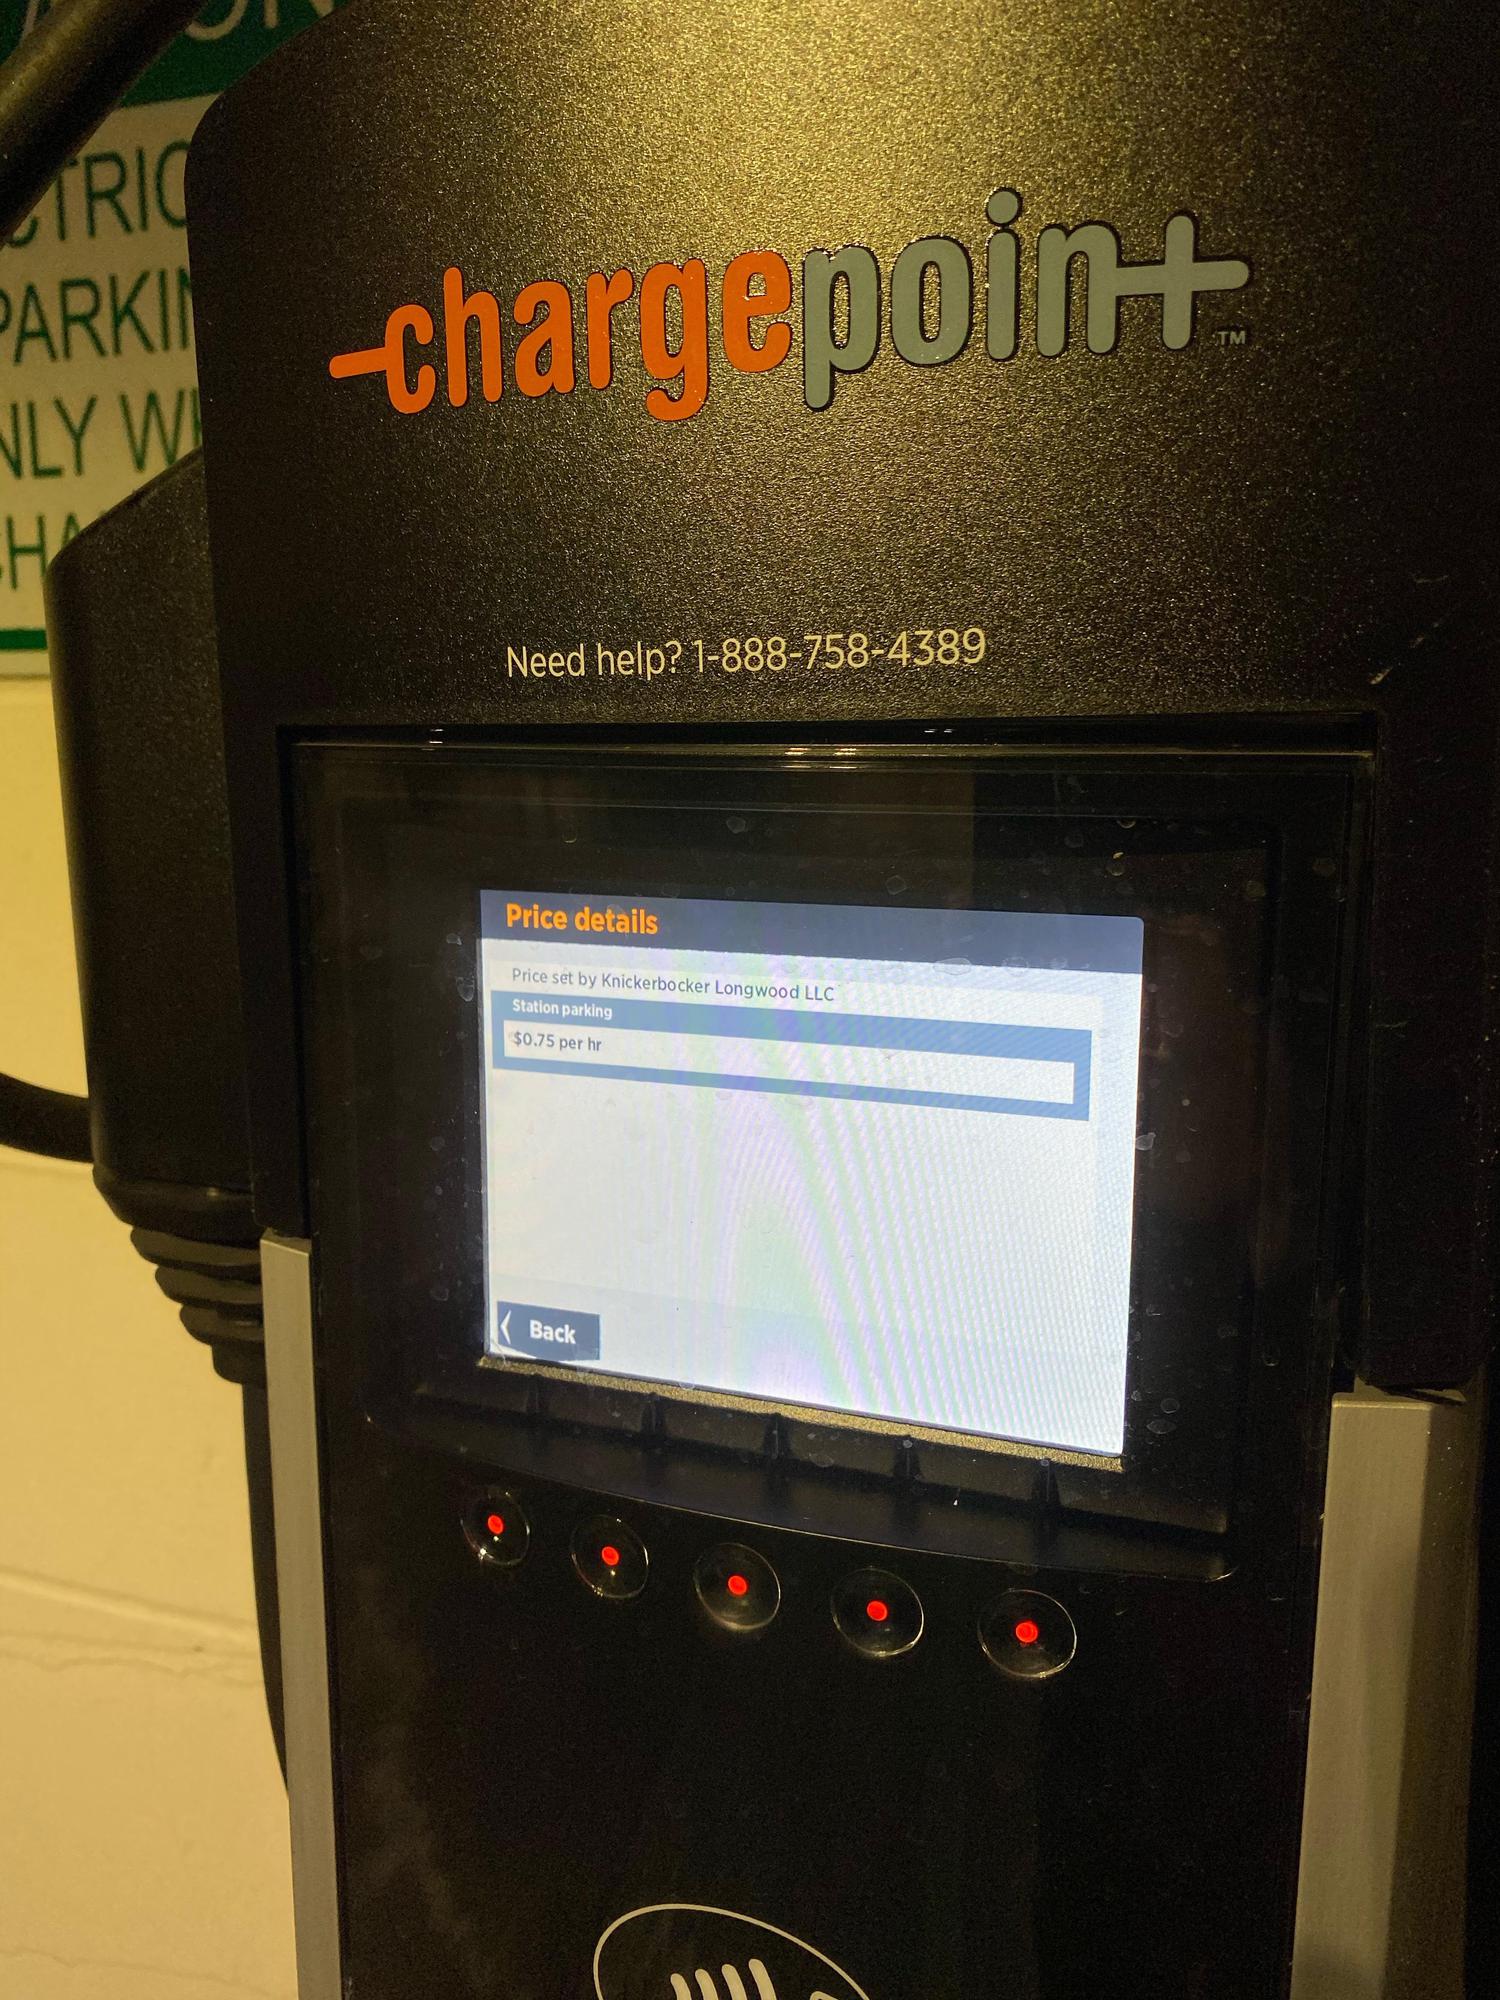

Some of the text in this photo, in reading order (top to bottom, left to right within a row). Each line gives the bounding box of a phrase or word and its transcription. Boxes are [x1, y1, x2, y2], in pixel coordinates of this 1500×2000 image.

[506, 627, 987, 680] Need help? 1-888-758-4389
[506, 903, 659, 935] Price details
[512, 968, 836, 1002] Price set by Knickerbocker Longwood LLC
[512, 998, 613, 1021] Station parking
[513, 1030, 602, 1052] $0.75 per hr
[529, 1319, 577, 1345] Back
